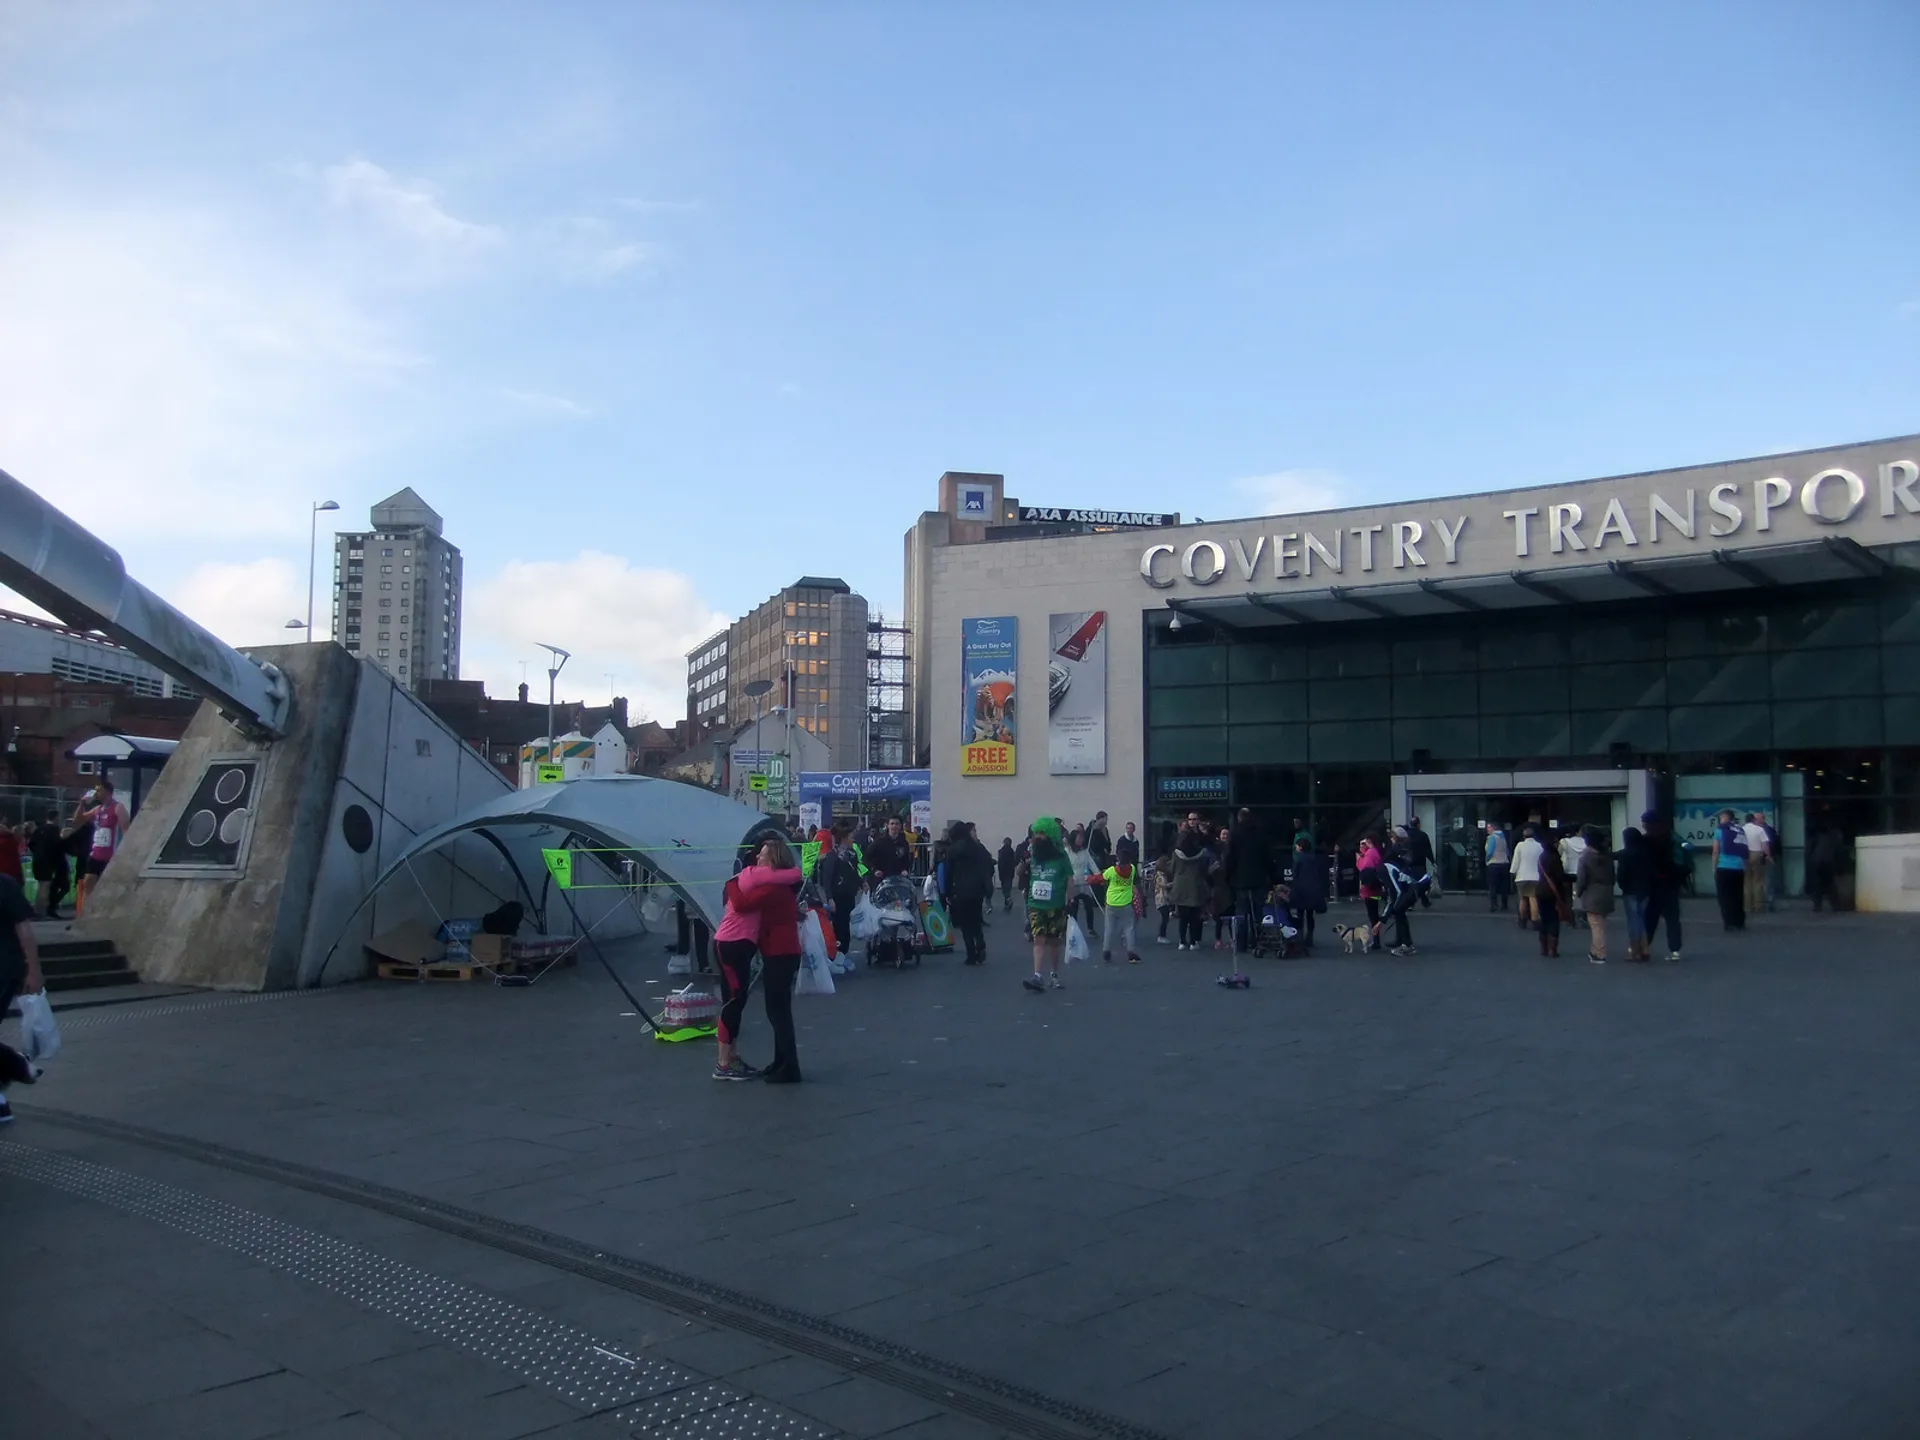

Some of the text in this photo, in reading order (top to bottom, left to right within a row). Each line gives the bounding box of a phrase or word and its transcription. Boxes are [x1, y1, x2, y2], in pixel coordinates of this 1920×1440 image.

[1025, 507, 1164, 527] AXA ASSURANCE
[1138, 459, 1920, 590] COVENTRY TRANSPOR
[967, 747, 1008, 764] FREE
[769, 760, 784, 778] JD
[967, 764, 1008, 772] ADMISSION
[832, 773, 899, 789] Coventry's
[1163, 779, 1222, 790] ESQUIRES
